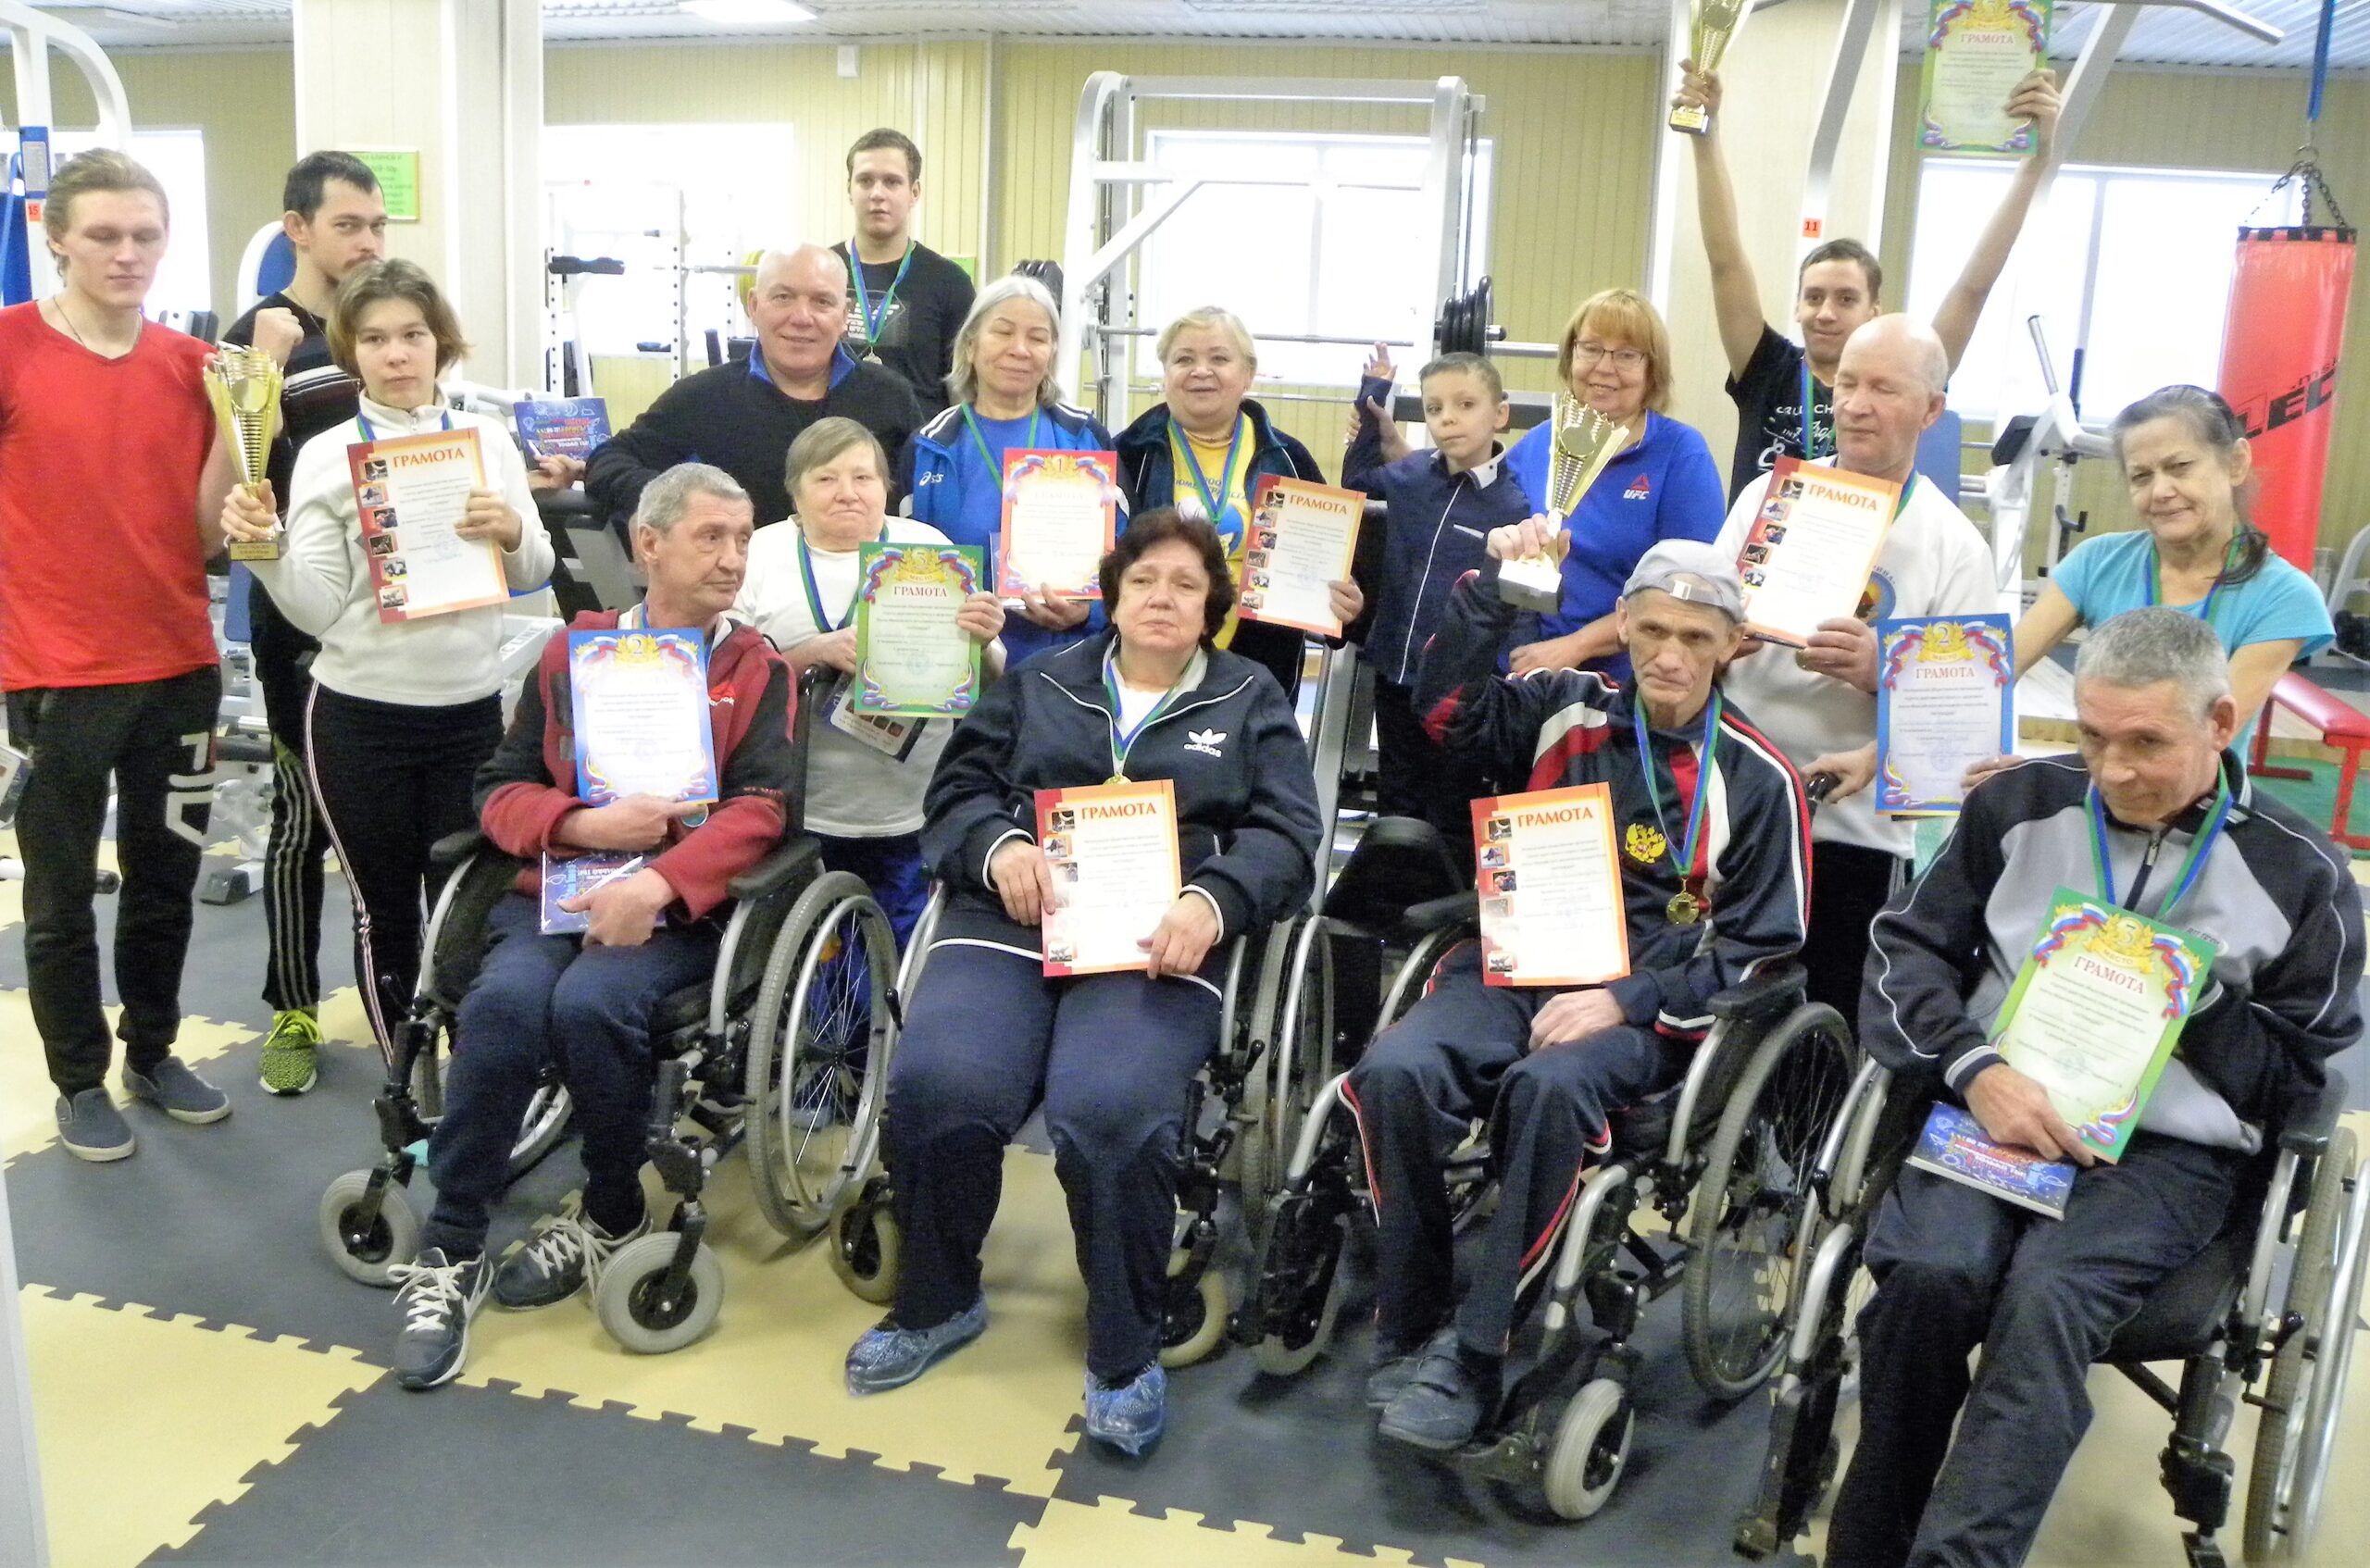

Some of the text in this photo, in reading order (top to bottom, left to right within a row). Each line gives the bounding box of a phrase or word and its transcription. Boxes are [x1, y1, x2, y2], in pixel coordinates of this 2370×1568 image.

[1961, 33, 2014, 44] ГРАМОТА
[28, 205, 39, 216] 15
[1805, 221, 1818, 231] 11
[393, 448, 465, 467] ГРАМОТА
[1623, 489, 1650, 500] UFC
[1808, 484, 1877, 511] ГРАМОТА
[1290, 494, 1348, 515] ГРАМОТА
[893, 586, 948, 598] ГРАМОТА
[1938, 627, 1949, 643] 2
[631, 638, 642, 654] 2
[1915, 666, 1976, 679] ГРАМОТА
[1183, 743, 1222, 757] adidas
[1081, 802, 1157, 820] ГРАМОТА
[1517, 807, 1593, 828] ГРАМОТА
[2118, 922, 2137, 944] 3
[2103, 947, 2134, 964] МЕСТО
[2074, 955, 2145, 995] ГРАМОТА
